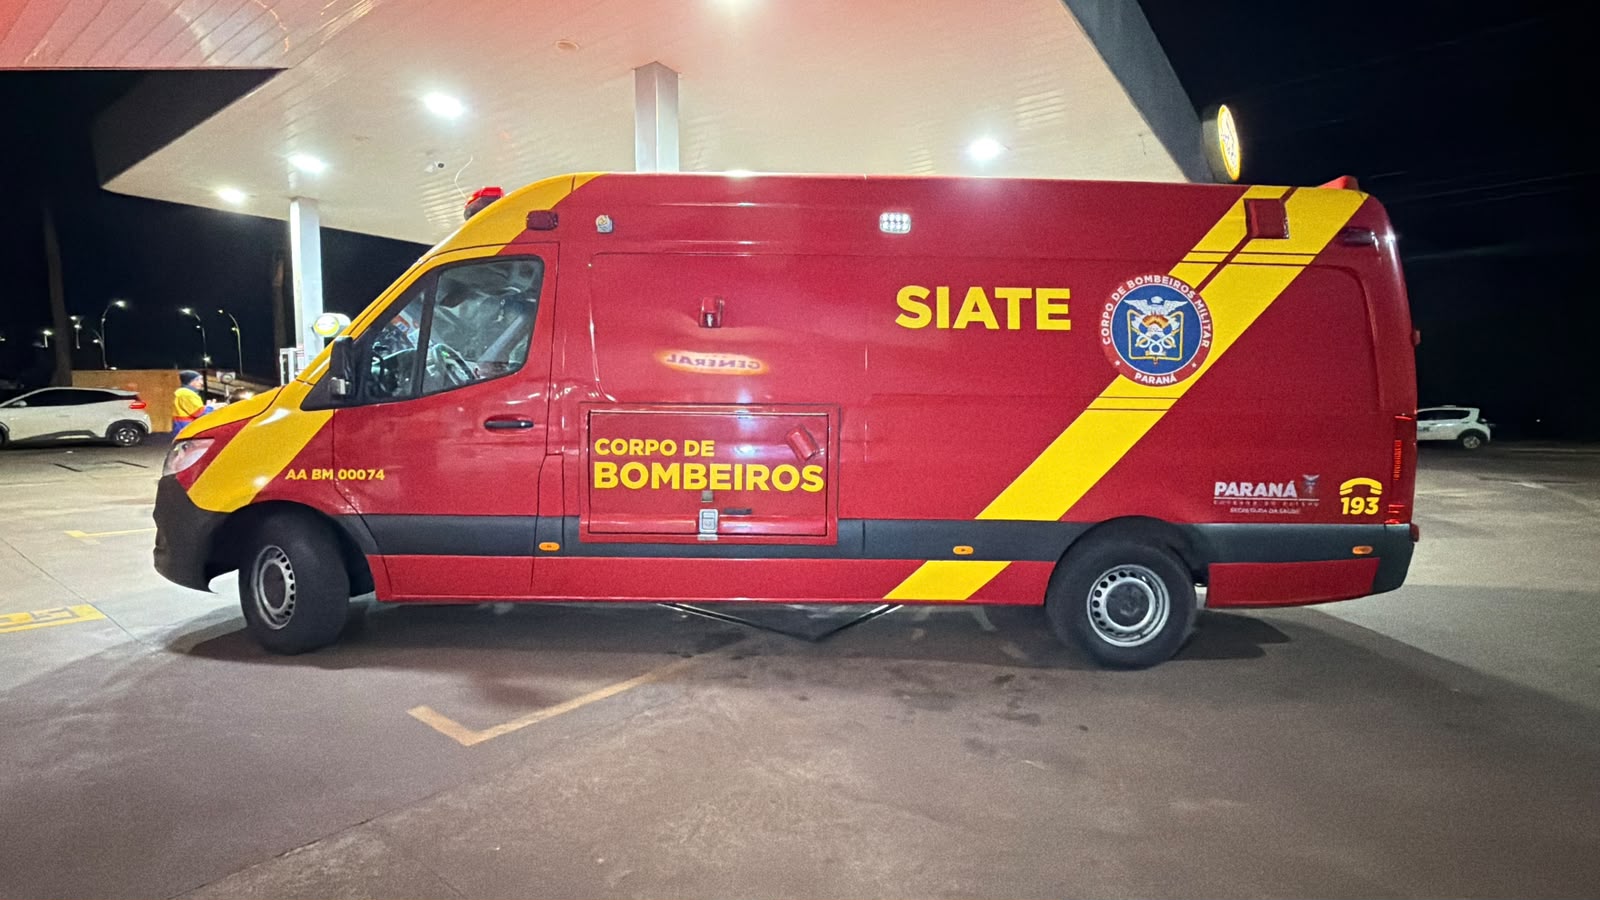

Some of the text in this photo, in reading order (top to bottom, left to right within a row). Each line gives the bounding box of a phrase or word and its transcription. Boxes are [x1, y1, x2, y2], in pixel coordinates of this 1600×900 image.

[895, 285, 1071, 330] SIATE
[1101, 275, 1212, 348] CORPO DE BOMBEIROS MILITAR
[1134, 373, 1178, 384] PARANÁ
[594, 438, 715, 457] CORPO DE
[285, 468, 385, 480] AA BM 00074
[594, 461, 824, 492] BOMBEIROS
[1214, 481, 1298, 498] PARANÁ
[1340, 497, 1380, 515] 193
